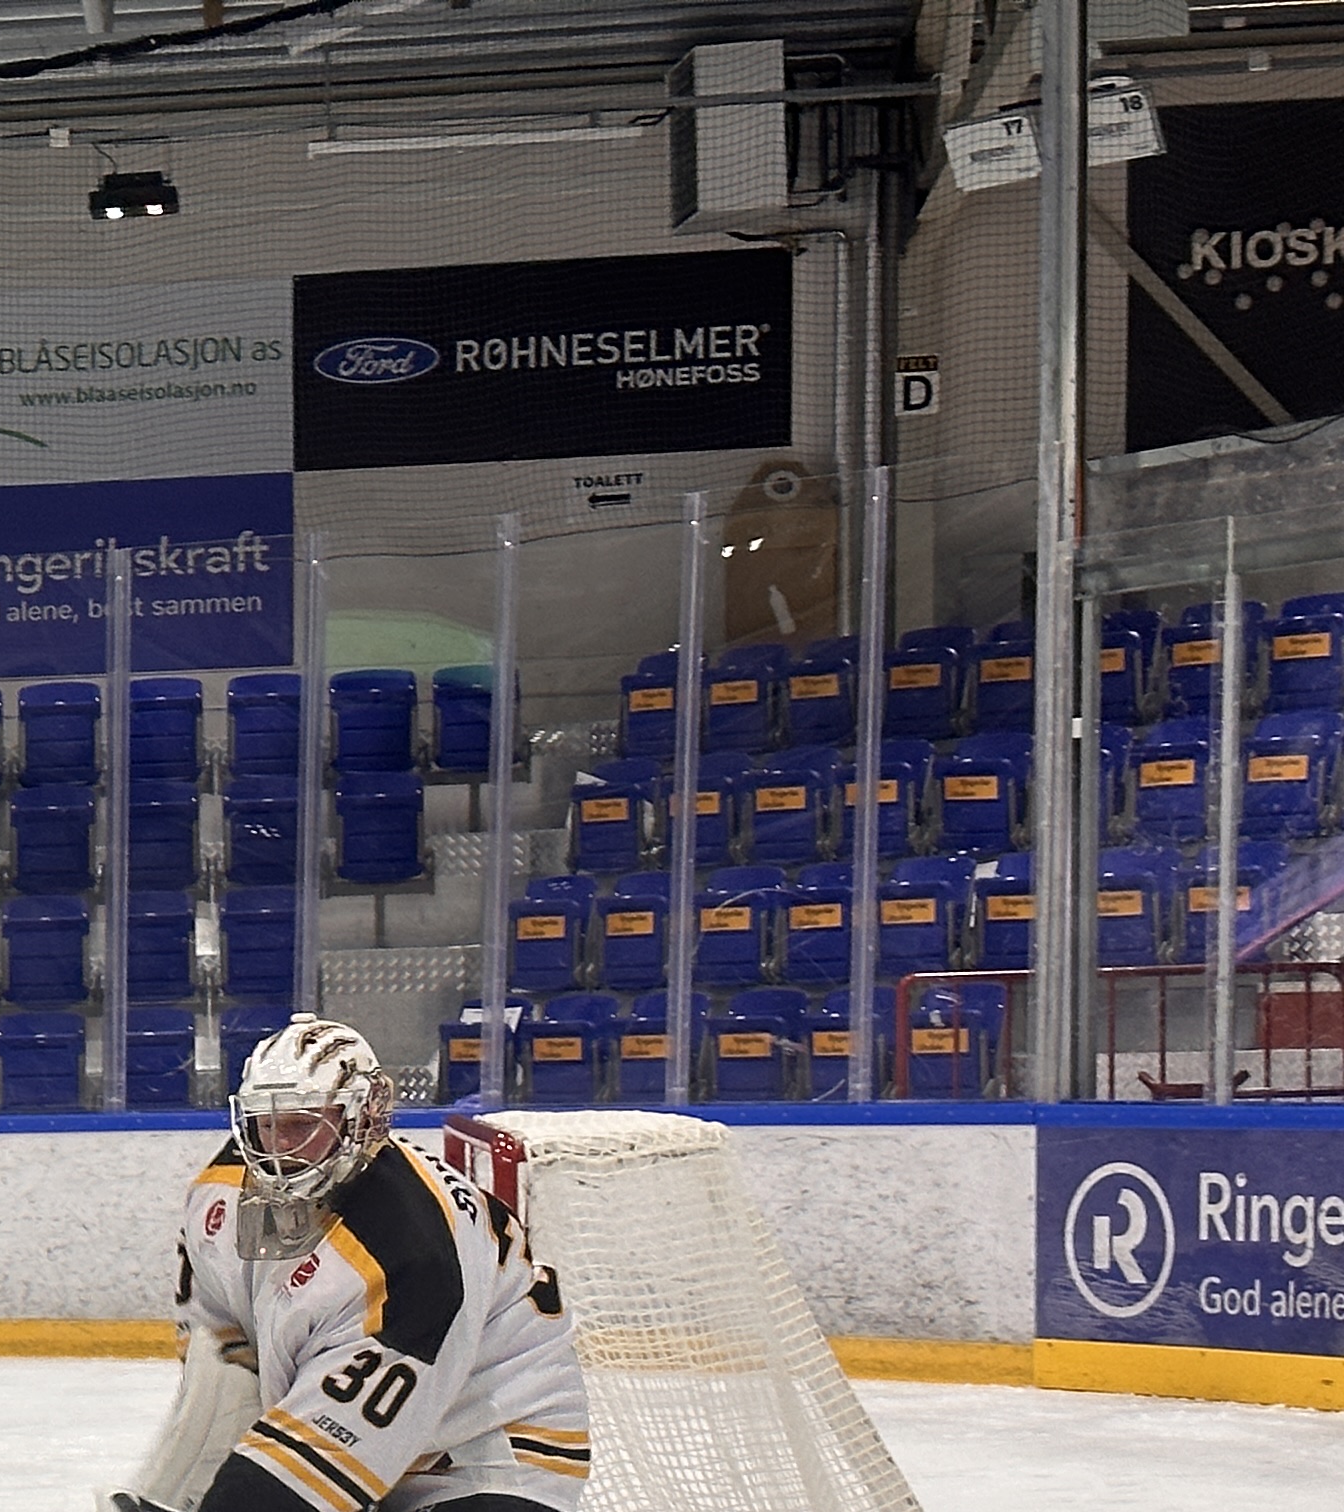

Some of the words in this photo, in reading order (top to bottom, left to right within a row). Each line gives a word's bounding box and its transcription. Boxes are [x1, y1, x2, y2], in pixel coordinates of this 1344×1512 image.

[1119, 94, 1142, 113] 18
[1003, 119, 1023, 136] 17
[252, 339, 282, 361] as
[338, 344, 413, 377] Ford
[455, 324, 762, 372] RØHNESELMER
[616, 363, 761, 389] HØNEFOSS
[903, 375, 932, 411] D
[573, 473, 643, 489] TOALETT
[6, 599, 80, 624] alene,
[88, 597, 143, 619] bt
[152, 594, 262, 617] sammen
[1198, 1172, 1344, 1268] Ringe
[1199, 1276, 1261, 1317] God
[321, 1349, 417, 1428] 30
